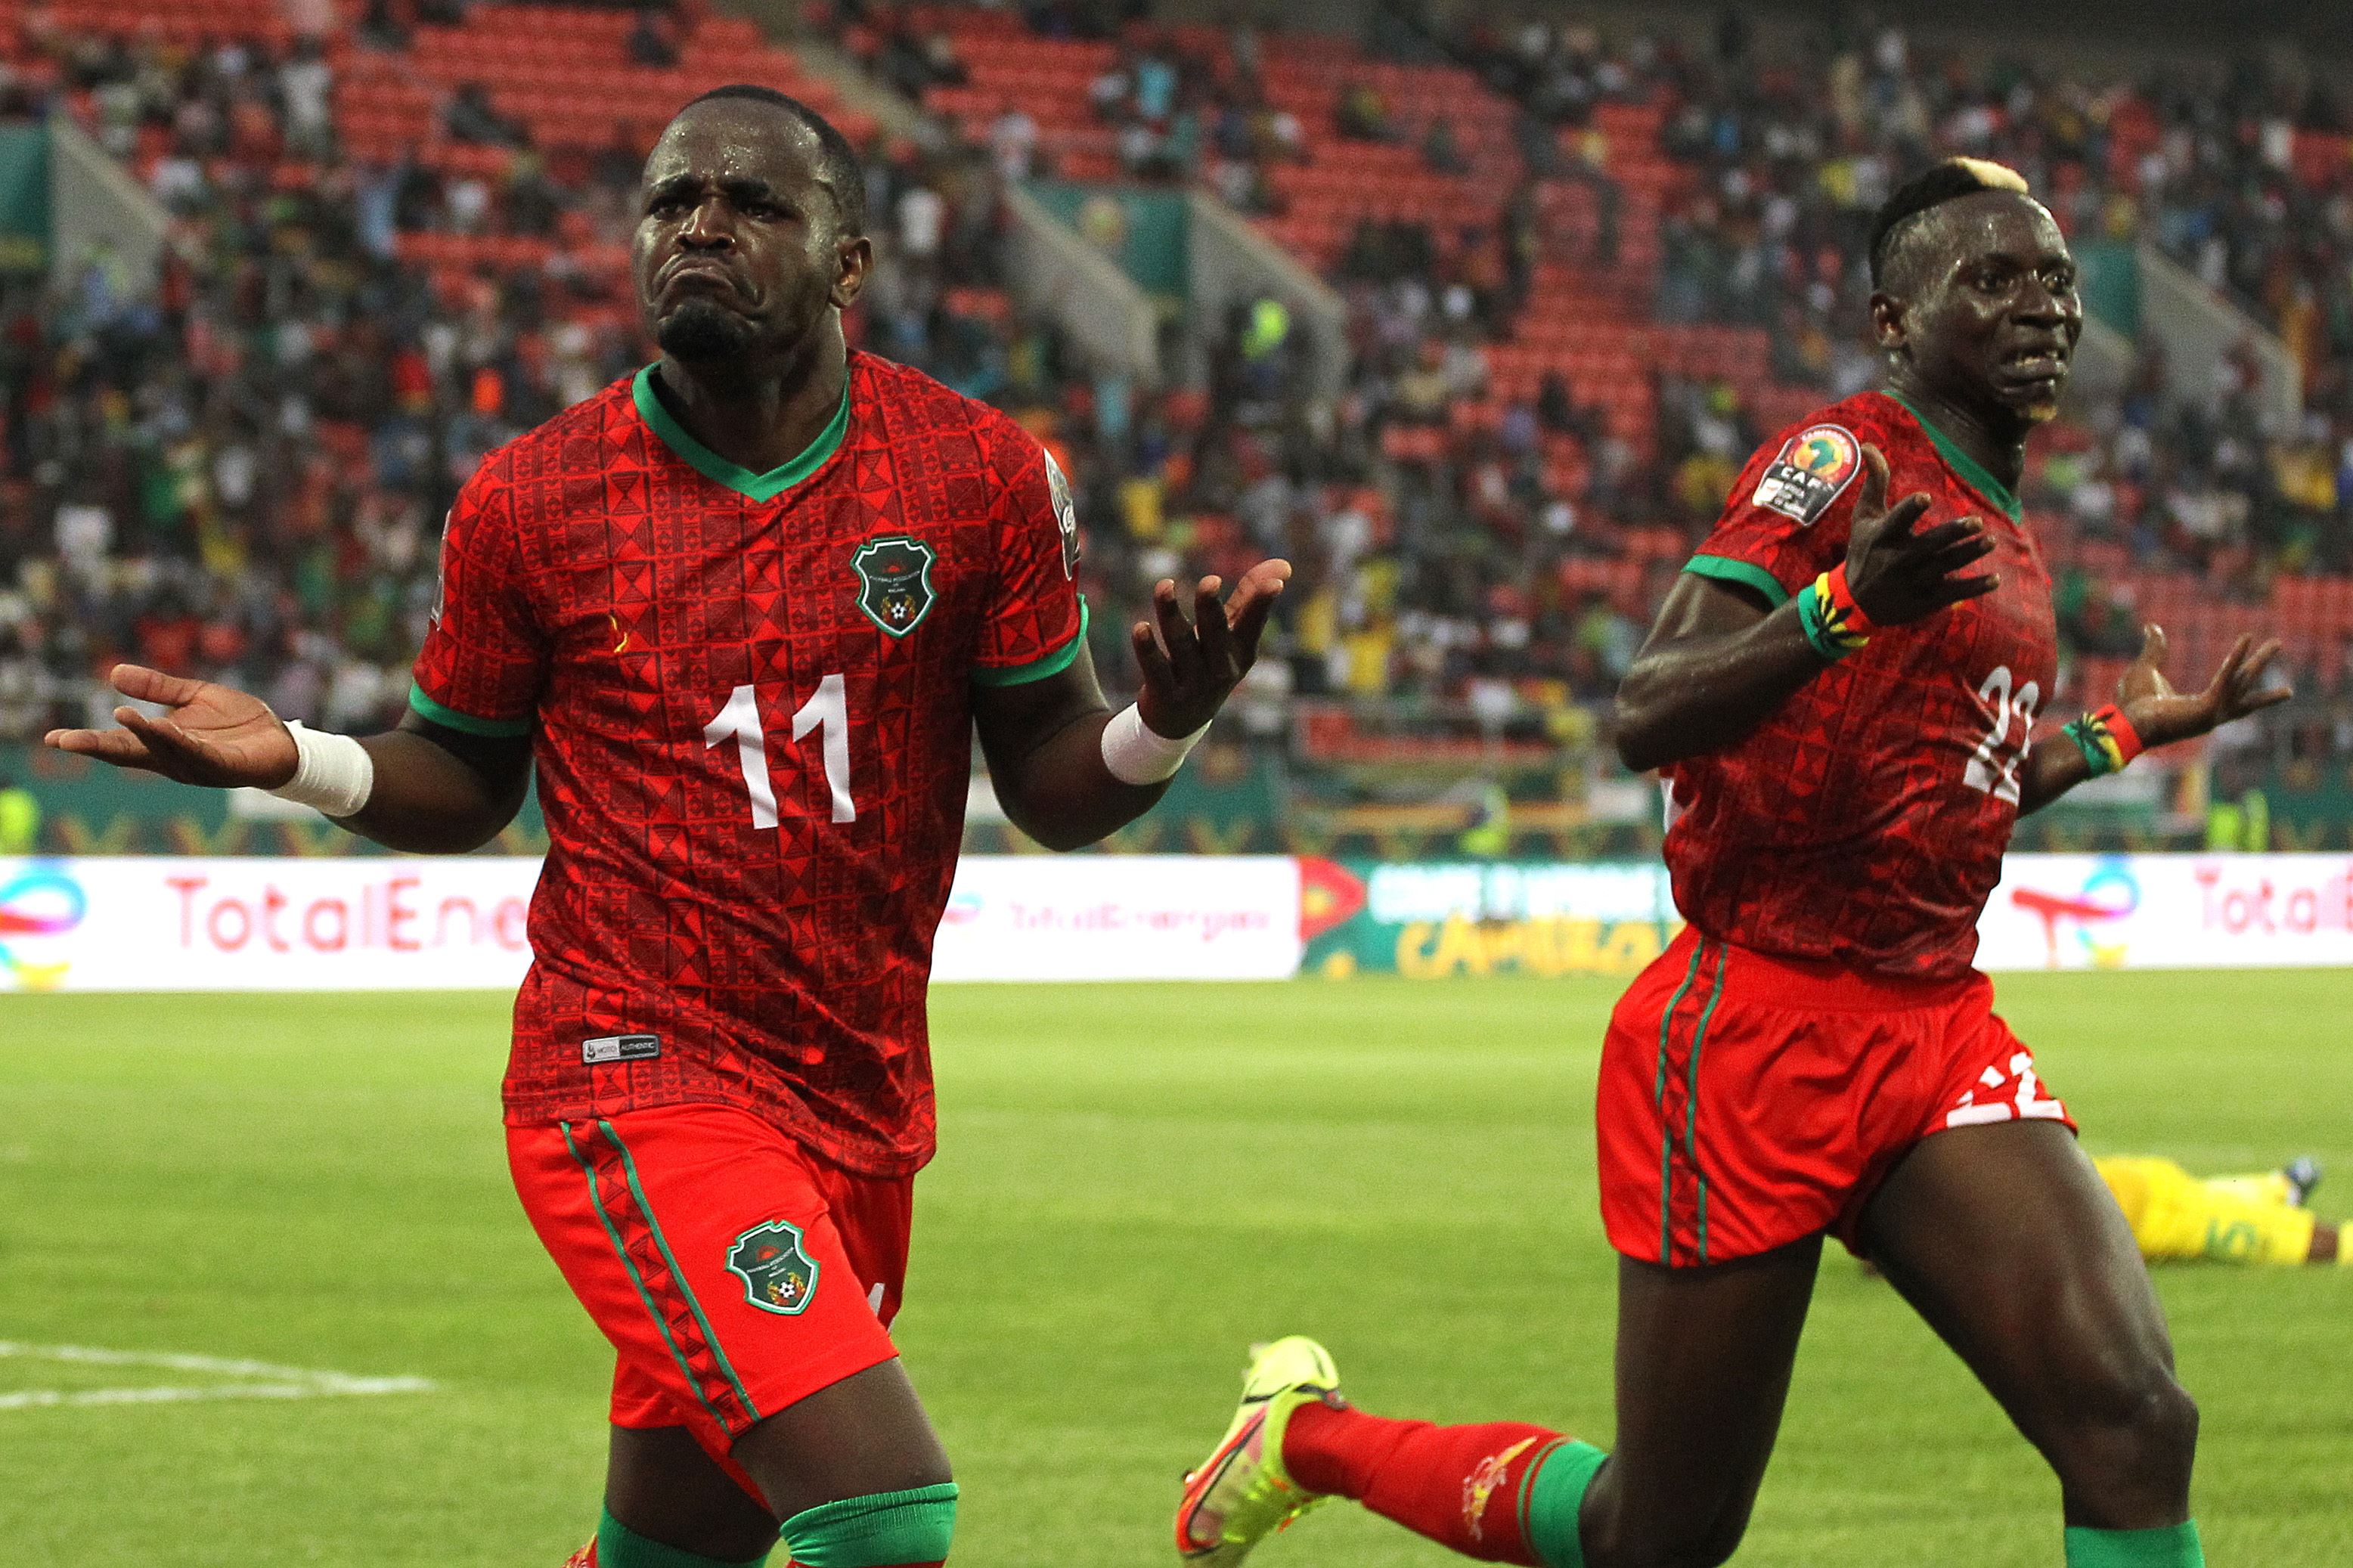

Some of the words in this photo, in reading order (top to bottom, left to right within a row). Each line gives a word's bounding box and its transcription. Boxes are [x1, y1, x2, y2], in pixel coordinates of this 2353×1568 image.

[703, 672, 856, 829] 11
[1963, 665, 2039, 807] 22
[1946, 1052, 2064, 1128] 22
